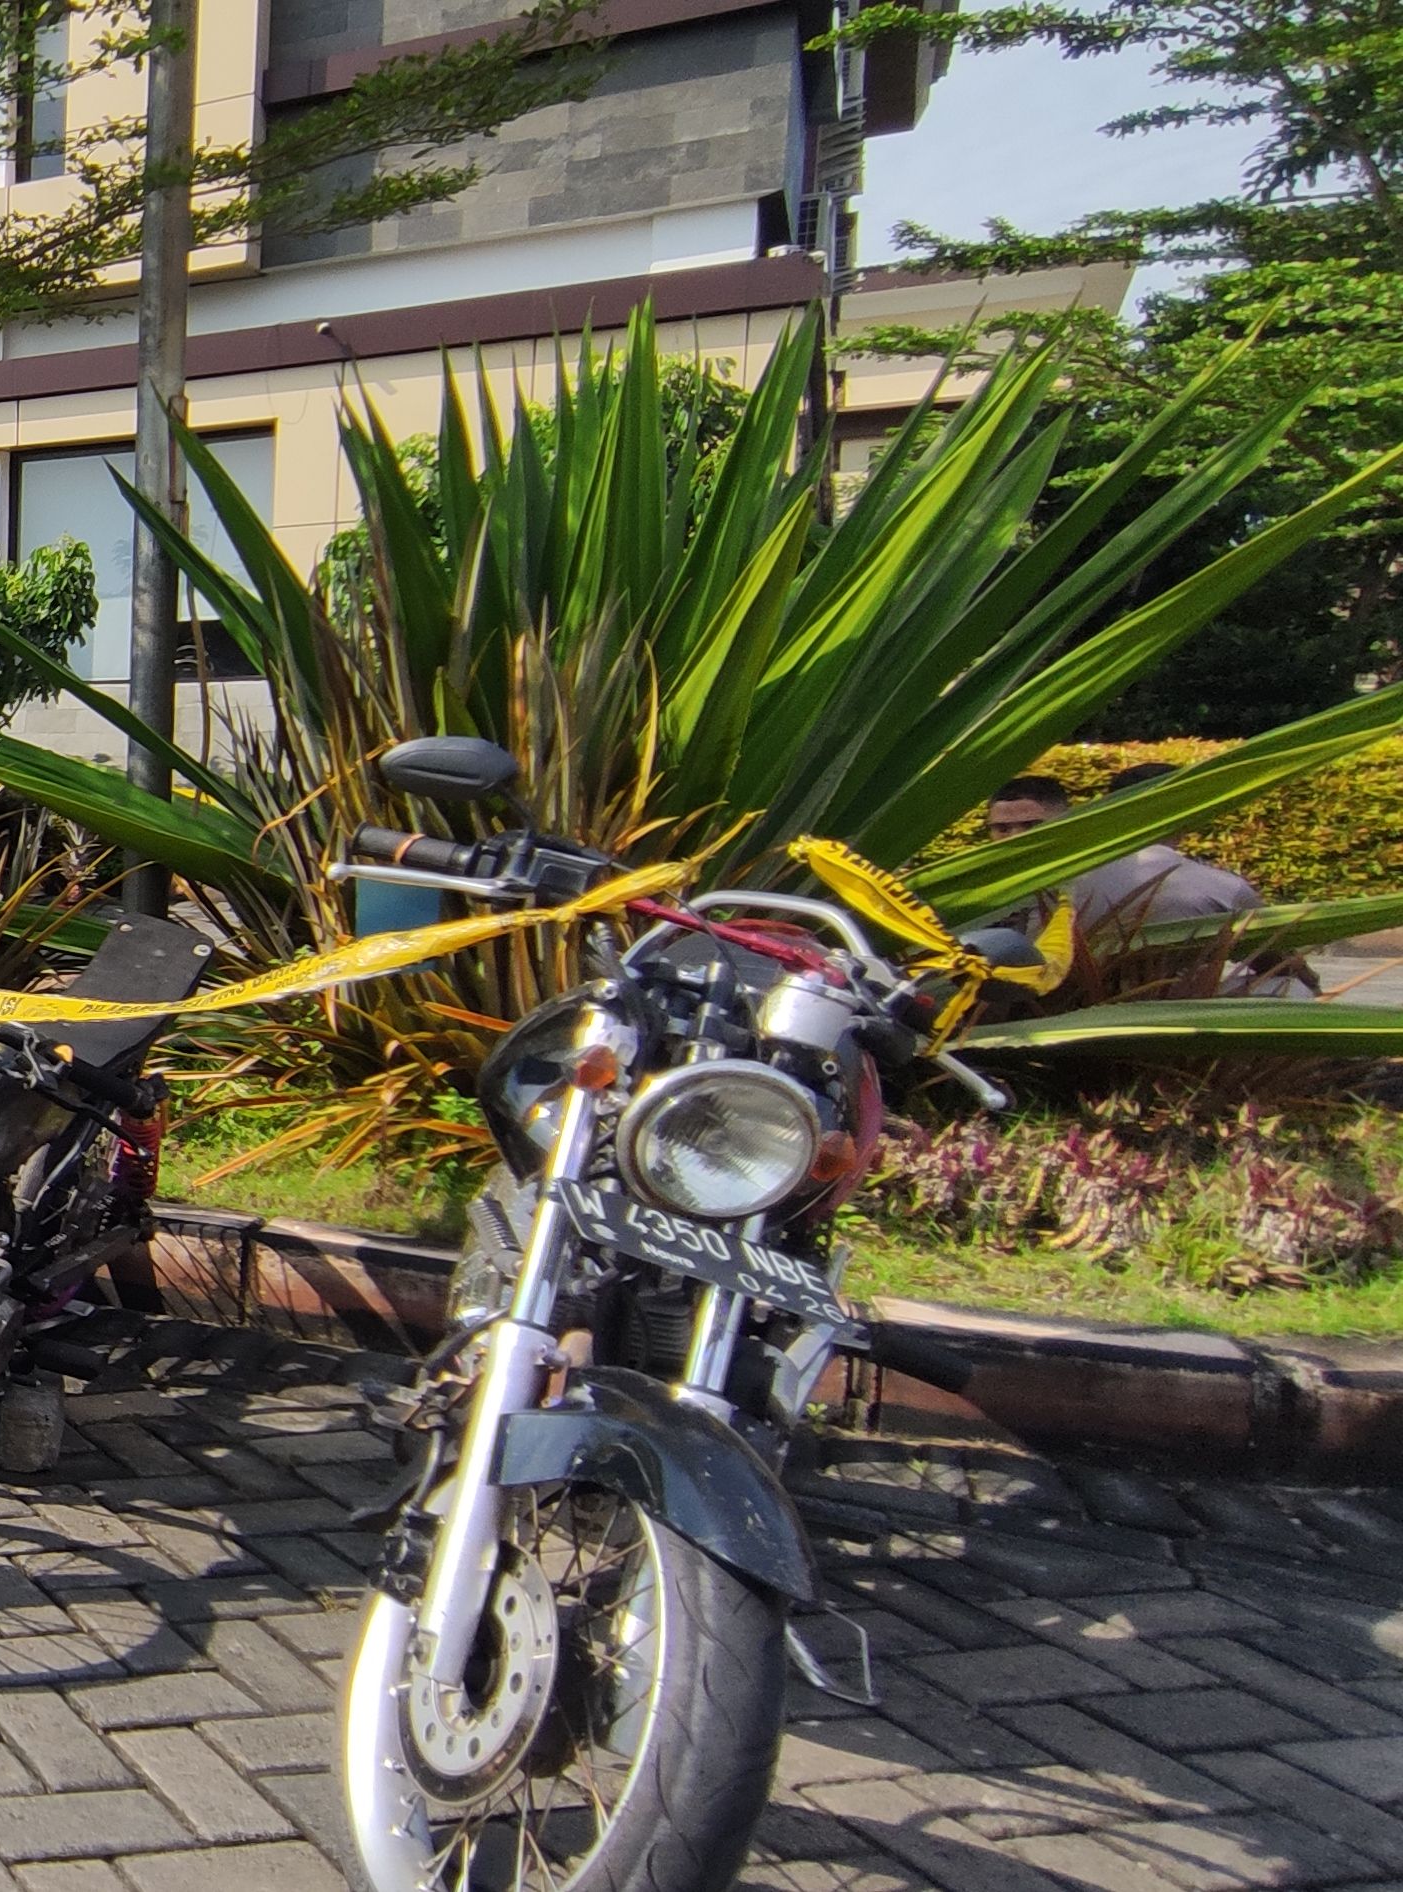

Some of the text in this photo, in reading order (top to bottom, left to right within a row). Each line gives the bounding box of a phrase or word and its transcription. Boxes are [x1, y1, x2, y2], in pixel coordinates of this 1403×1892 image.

[571, 1182, 830, 1297] W 4350 NBE
